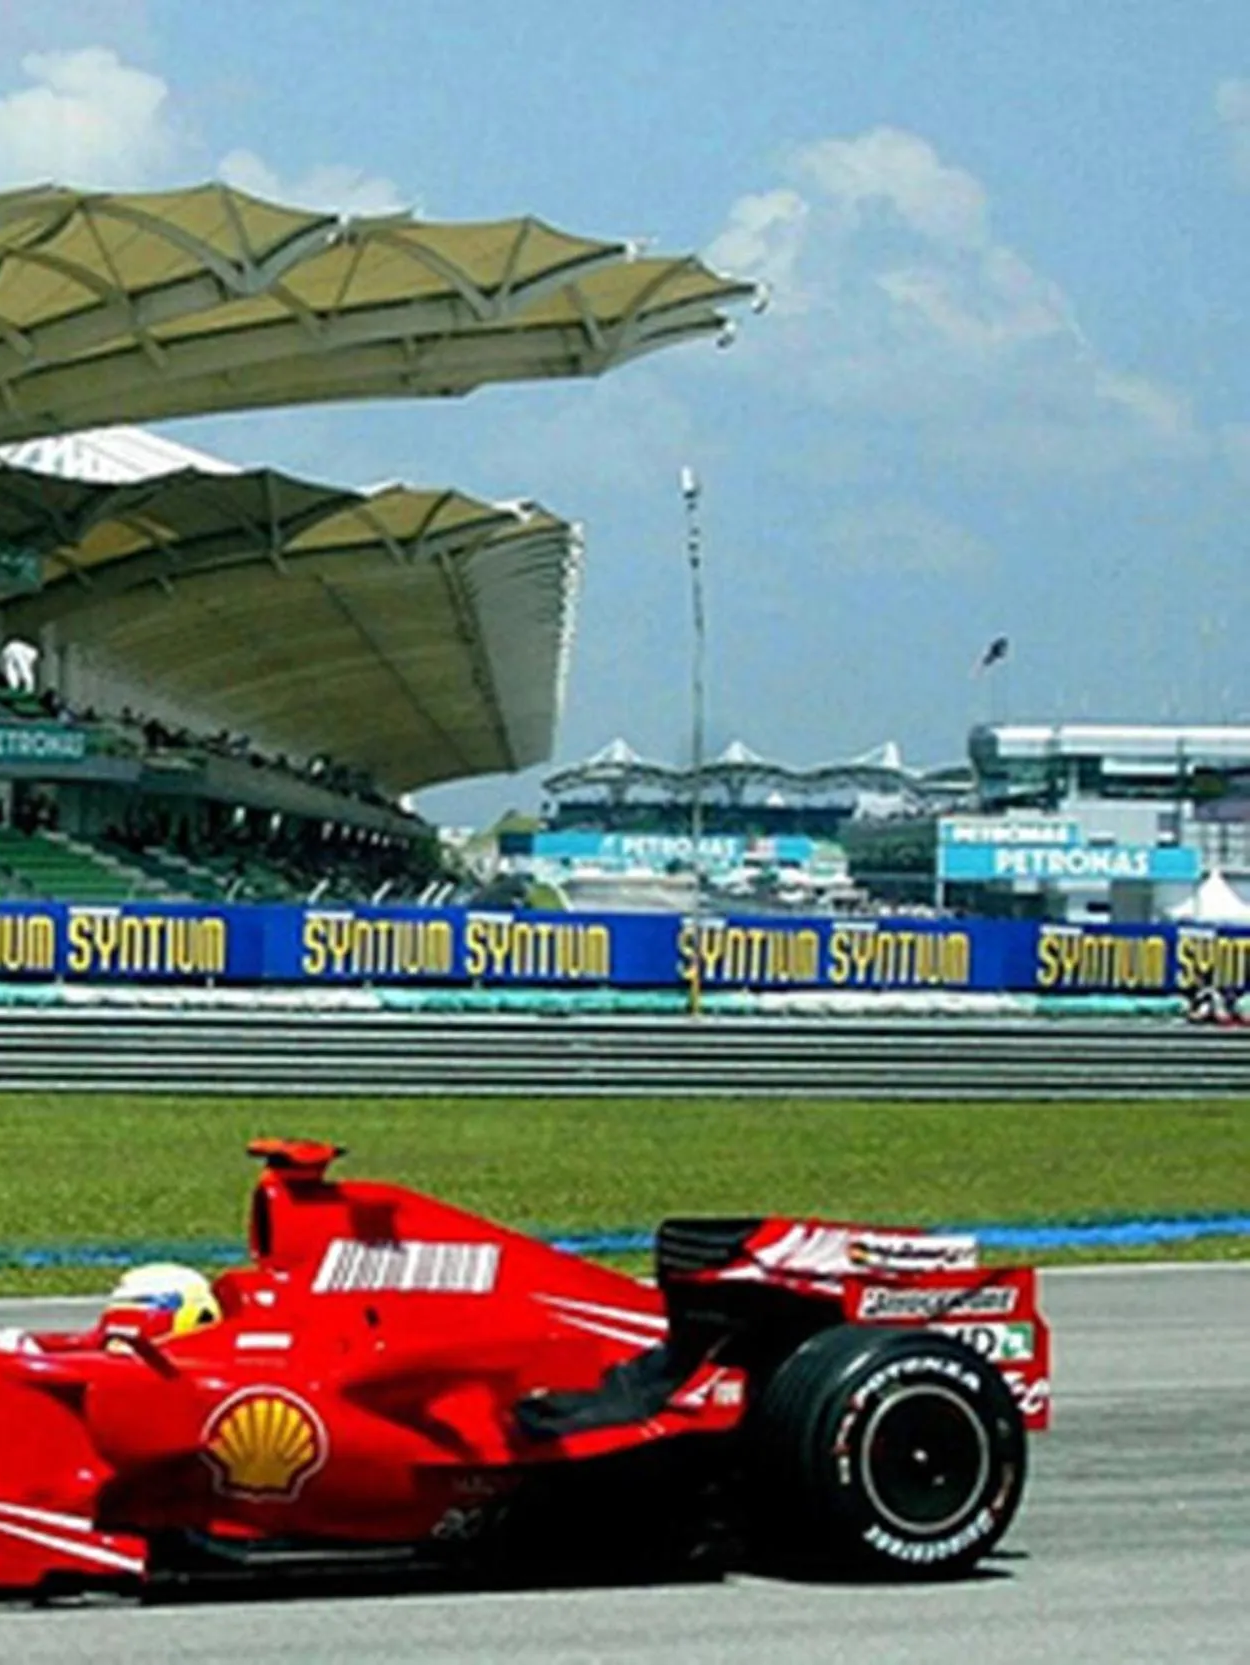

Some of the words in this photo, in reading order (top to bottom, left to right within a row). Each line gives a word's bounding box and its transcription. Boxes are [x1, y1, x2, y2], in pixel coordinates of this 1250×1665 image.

[994, 848, 1149, 876] PETRONAS
[67, 914, 226, 973] SYNTIUM
[303, 916, 452, 975] SYNTIUM
[464, 918, 611, 977] SYNTIUM
[676, 923, 820, 982] SYNTIUM
[828, 928, 969, 984] SYNTIUM
[1036, 934, 1166, 988] SYNTIUM
